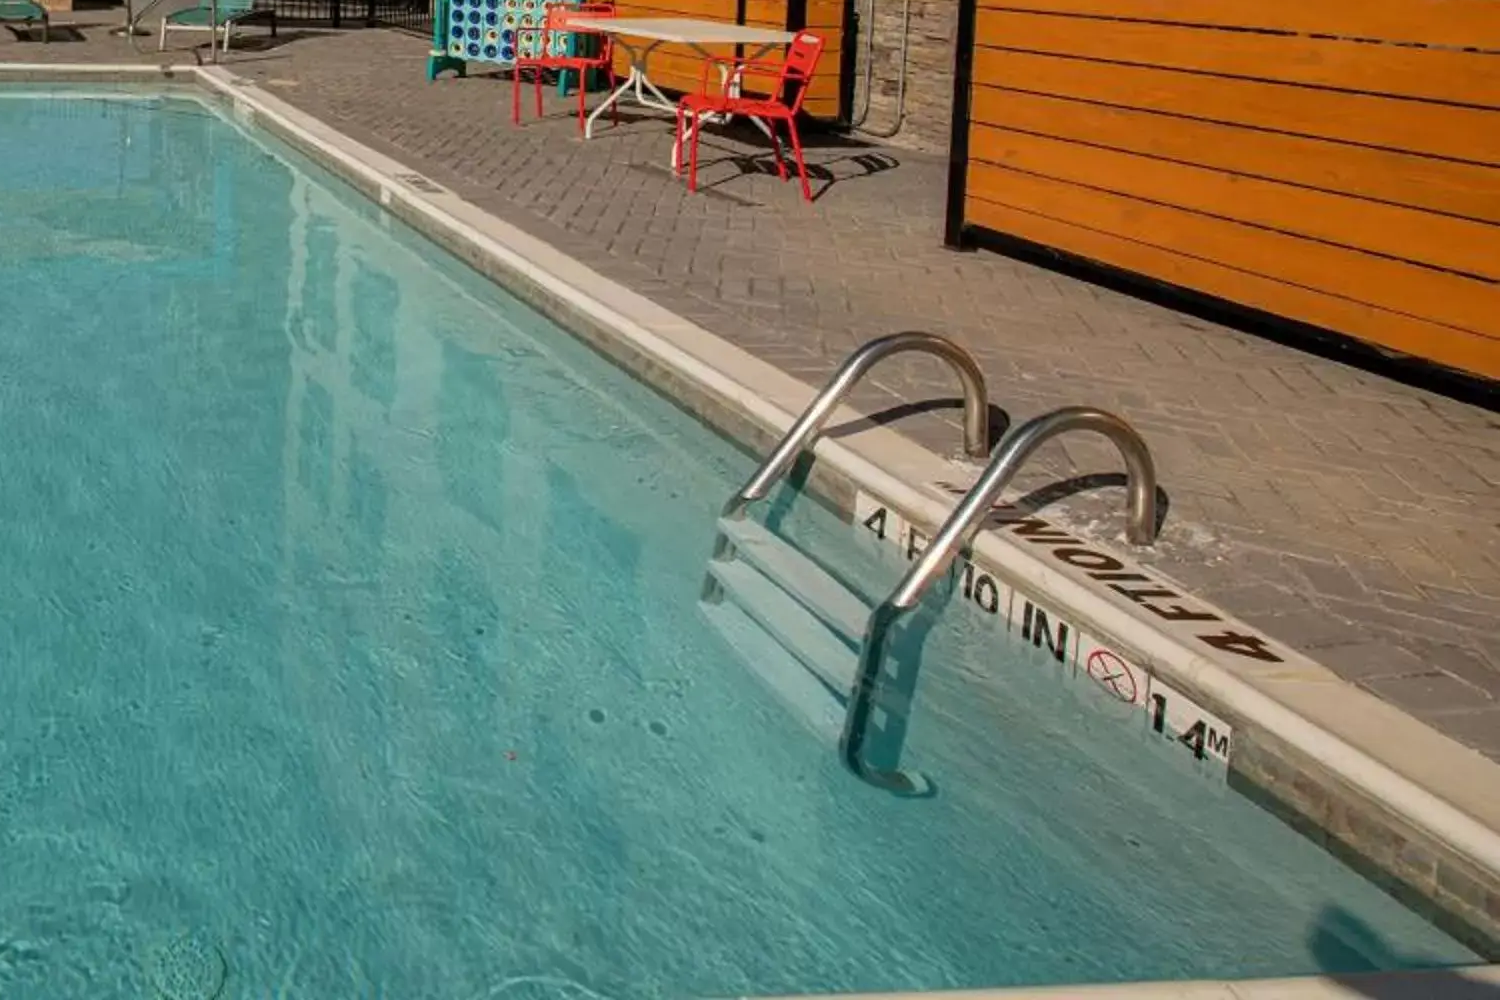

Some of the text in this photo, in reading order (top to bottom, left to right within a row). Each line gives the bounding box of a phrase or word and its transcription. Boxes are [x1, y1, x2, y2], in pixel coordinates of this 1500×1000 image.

[863, 507, 887, 540] 4
[964, 561, 998, 614] 10
[1022, 602, 1069, 663] IN
[1195, 630, 1284, 665] 4
